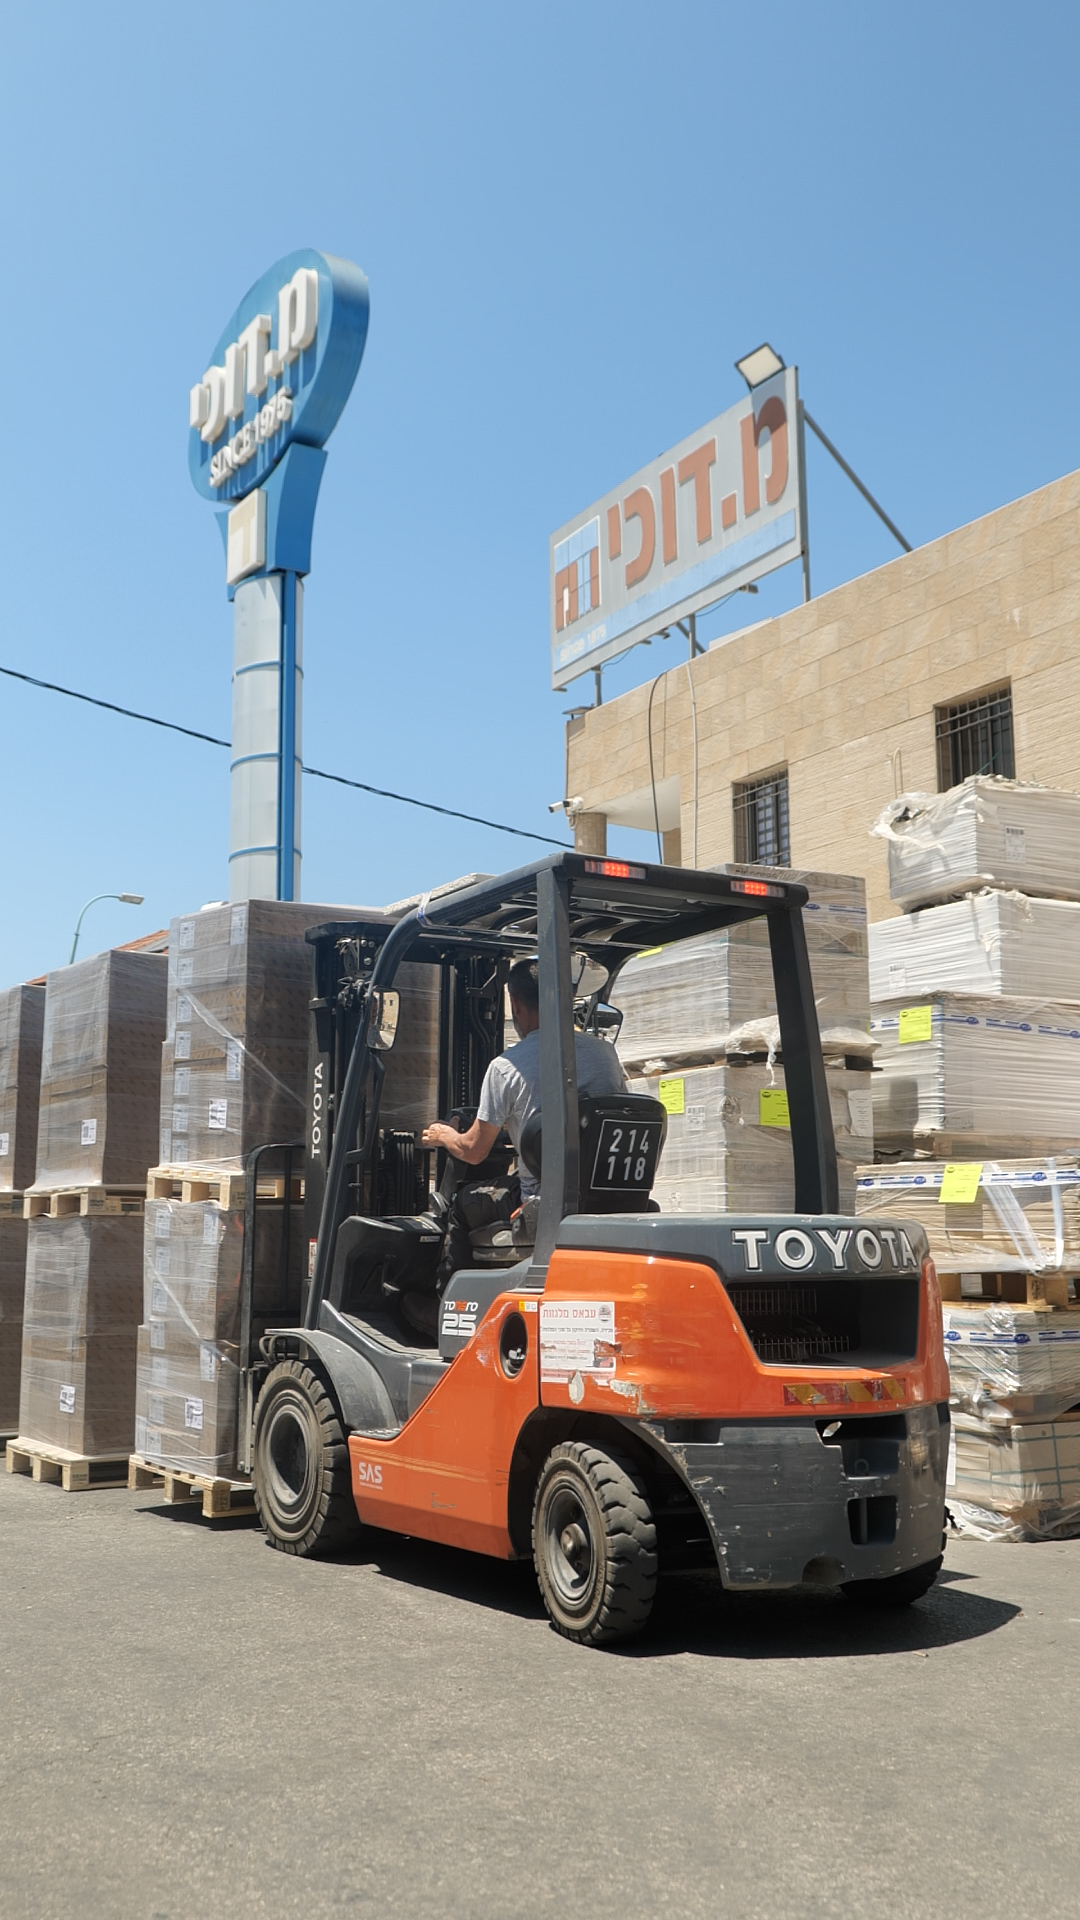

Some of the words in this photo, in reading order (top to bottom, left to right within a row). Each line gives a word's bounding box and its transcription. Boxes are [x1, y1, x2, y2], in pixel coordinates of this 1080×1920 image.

[209, 421, 257, 488] SINCE
[254, 385, 293, 443] 1975
[311, 1062, 324, 1159] TOYOTA
[609, 1128, 649, 1154] 214
[607, 1155, 646, 1181] 118
[731, 1228, 919, 1271] TOYOTA
[441, 1313, 477, 1336] 25
[358, 1461, 383, 1484] SAS
